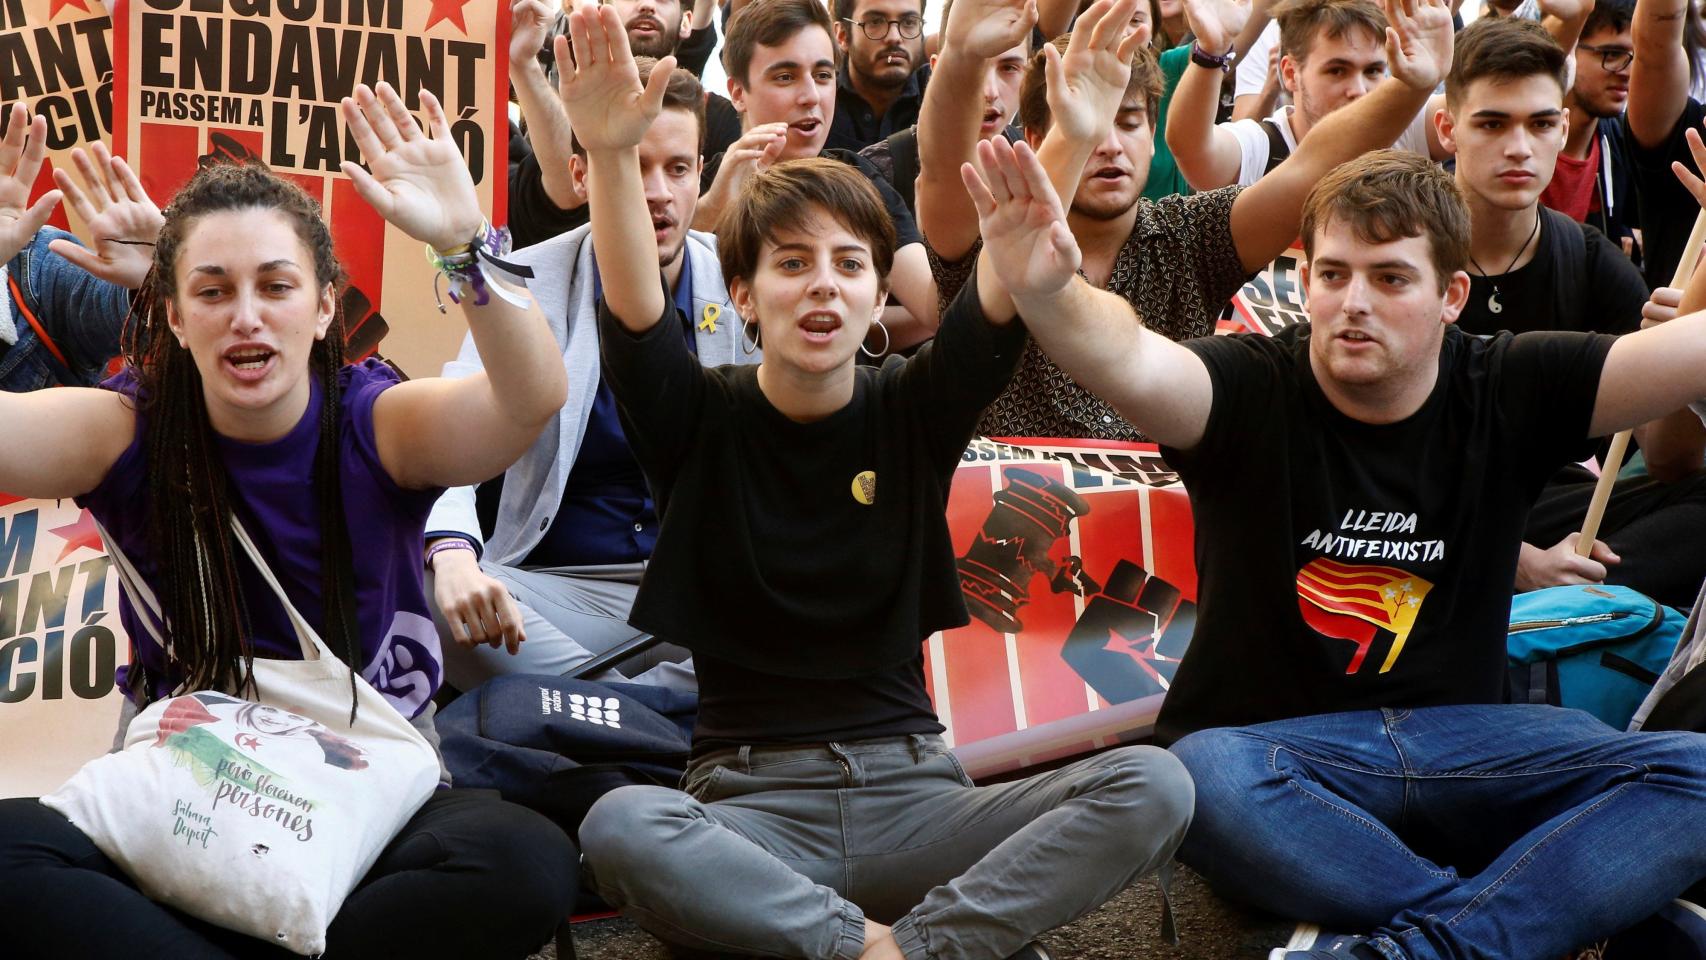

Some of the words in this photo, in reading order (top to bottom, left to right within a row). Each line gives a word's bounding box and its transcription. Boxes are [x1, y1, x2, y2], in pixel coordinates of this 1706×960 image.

[140, 12, 486, 111] ENDAVANT
[140, 90, 242, 125] PASSEM
[248, 99, 264, 127] A
[270, 101, 486, 188] L'AÓ
[1242, 255, 1307, 313] SE
[1301, 528, 1446, 562] ANTIFEIXISTA
[1340, 508, 1418, 534] LLEIDA
[212, 779, 313, 842] persones
